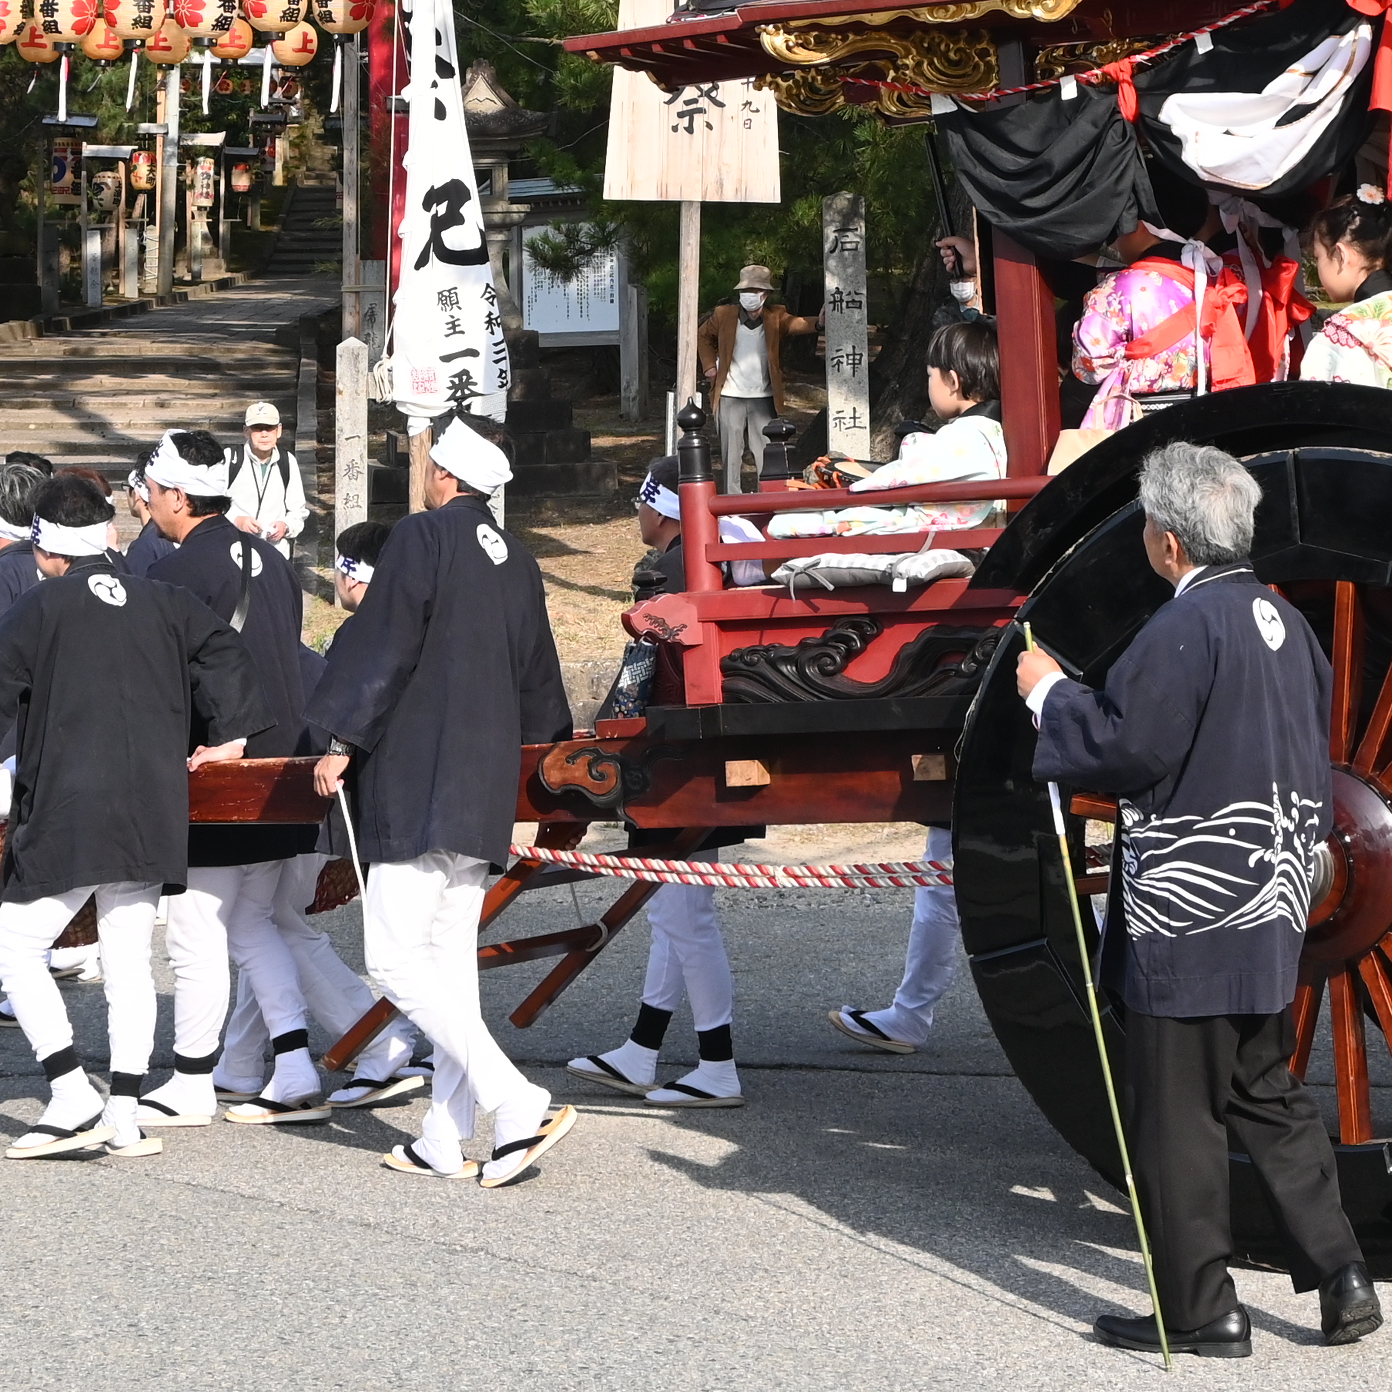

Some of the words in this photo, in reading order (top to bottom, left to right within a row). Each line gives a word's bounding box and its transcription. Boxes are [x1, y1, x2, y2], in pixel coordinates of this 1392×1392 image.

[20, 25, 48, 49] 上
[95, 26, 121, 50] 上
[146, 29, 173, 52] 上
[217, 28, 247, 49] 上
[292, 30, 316, 55] 上
[436, 286, 466, 338] 願主
[828, 227, 868, 432] 石船神社
[341, 434, 363, 511] 一番組
